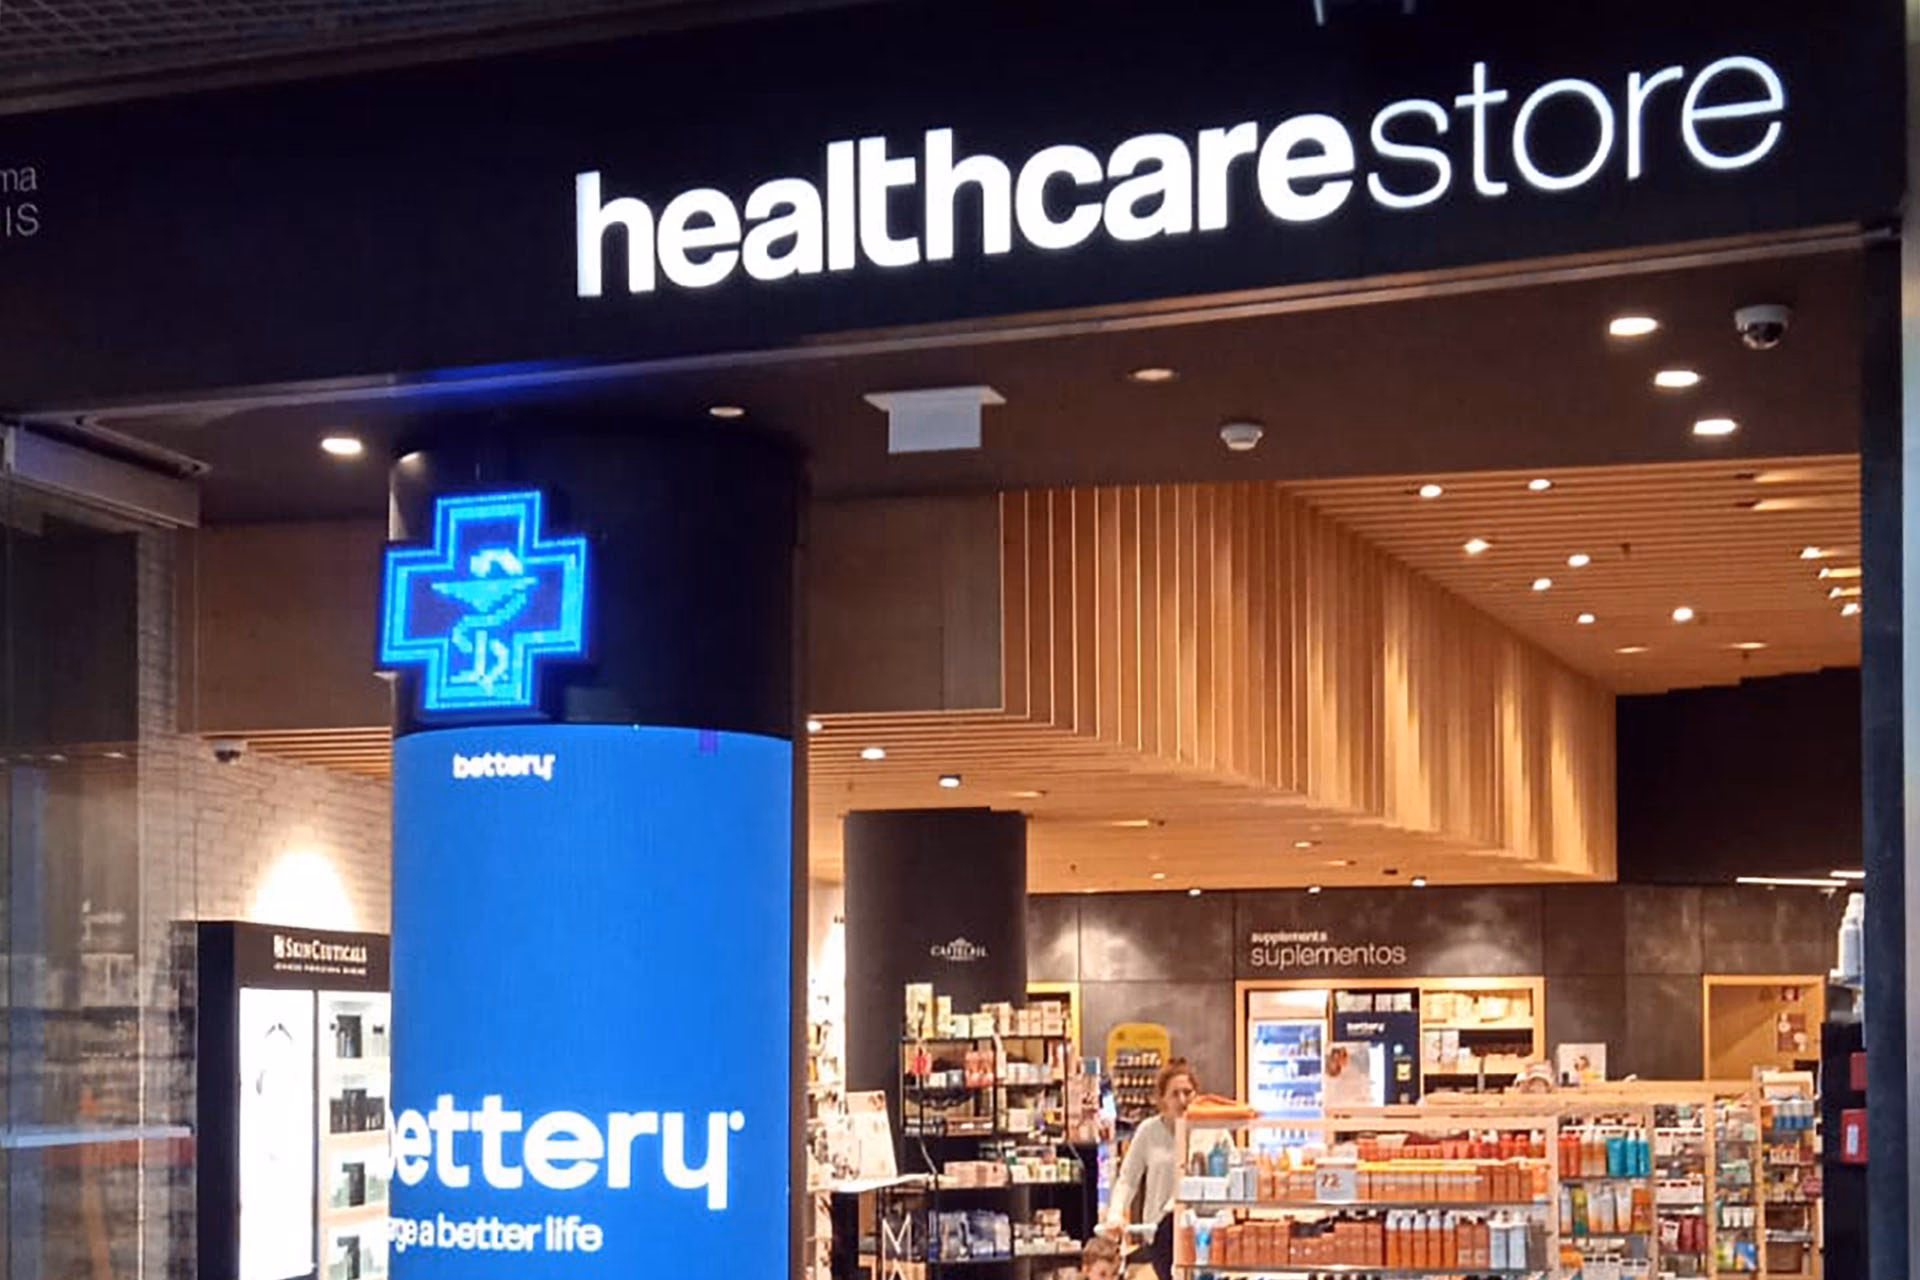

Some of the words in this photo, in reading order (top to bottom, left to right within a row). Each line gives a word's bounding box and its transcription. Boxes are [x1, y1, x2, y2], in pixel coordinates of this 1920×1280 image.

[1251, 942, 1407, 970] suplementos
[388, 1094, 729, 1210] ettery
[437, 1212, 542, 1252] better
[545, 1214, 604, 1252] life
